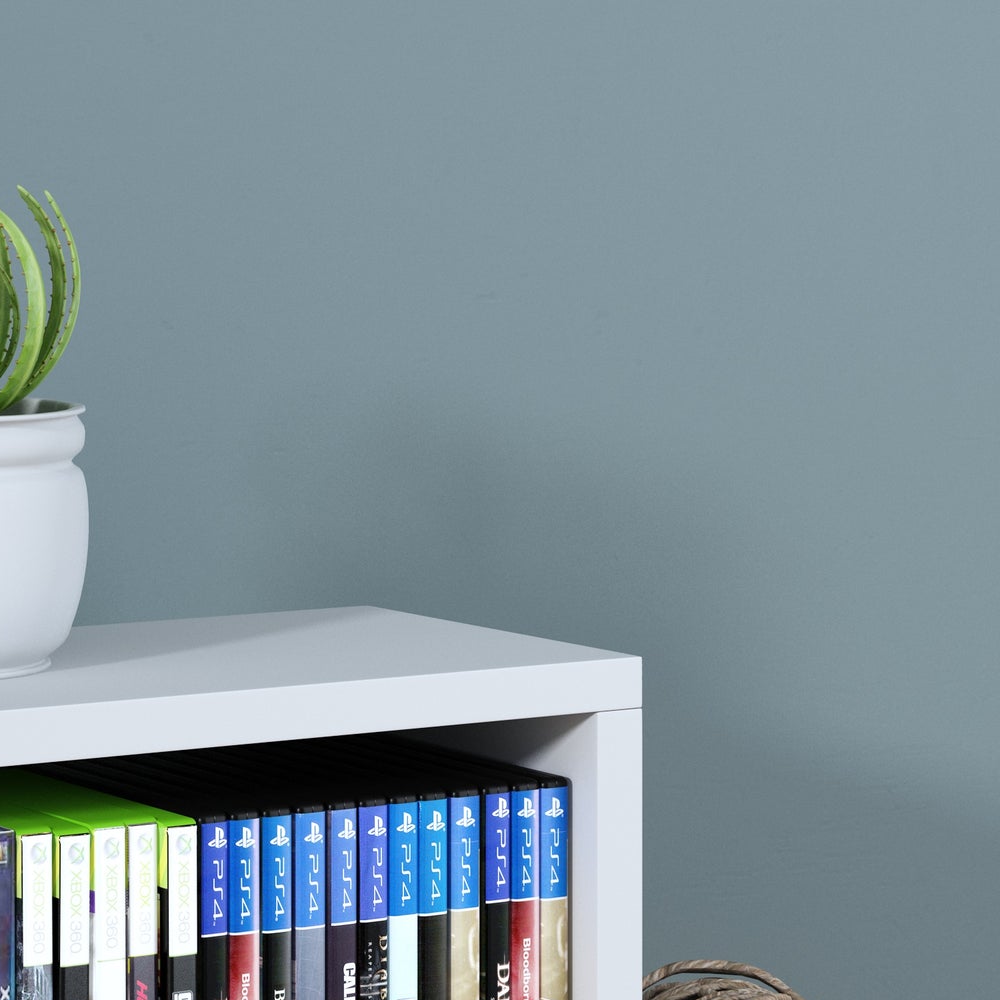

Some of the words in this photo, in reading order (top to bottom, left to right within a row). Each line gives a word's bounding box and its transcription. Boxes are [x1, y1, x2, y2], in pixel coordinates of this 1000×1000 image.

[139, 861, 152, 908] XBOX
[178, 862, 191, 909] XBOX
[275, 856, 285, 917] PS4
[309, 854, 319, 914] PS4
[342, 850, 352, 911] PS4
[372, 847, 383, 908] PS4
[401, 843, 411, 904] PS4
[431, 842, 441, 900] PS4
[461, 838, 471, 897] PS4
[496, 829, 506, 888] PS4
[522, 828, 531, 887] PS4
[550, 828, 560, 887] PS4
[33, 870, 45, 917] XBOX
[70, 870, 82, 917] XBOX
[105, 865, 118, 912] XBOX
[213, 859, 223, 919] PS4
[240, 859, 251, 919] PS4
